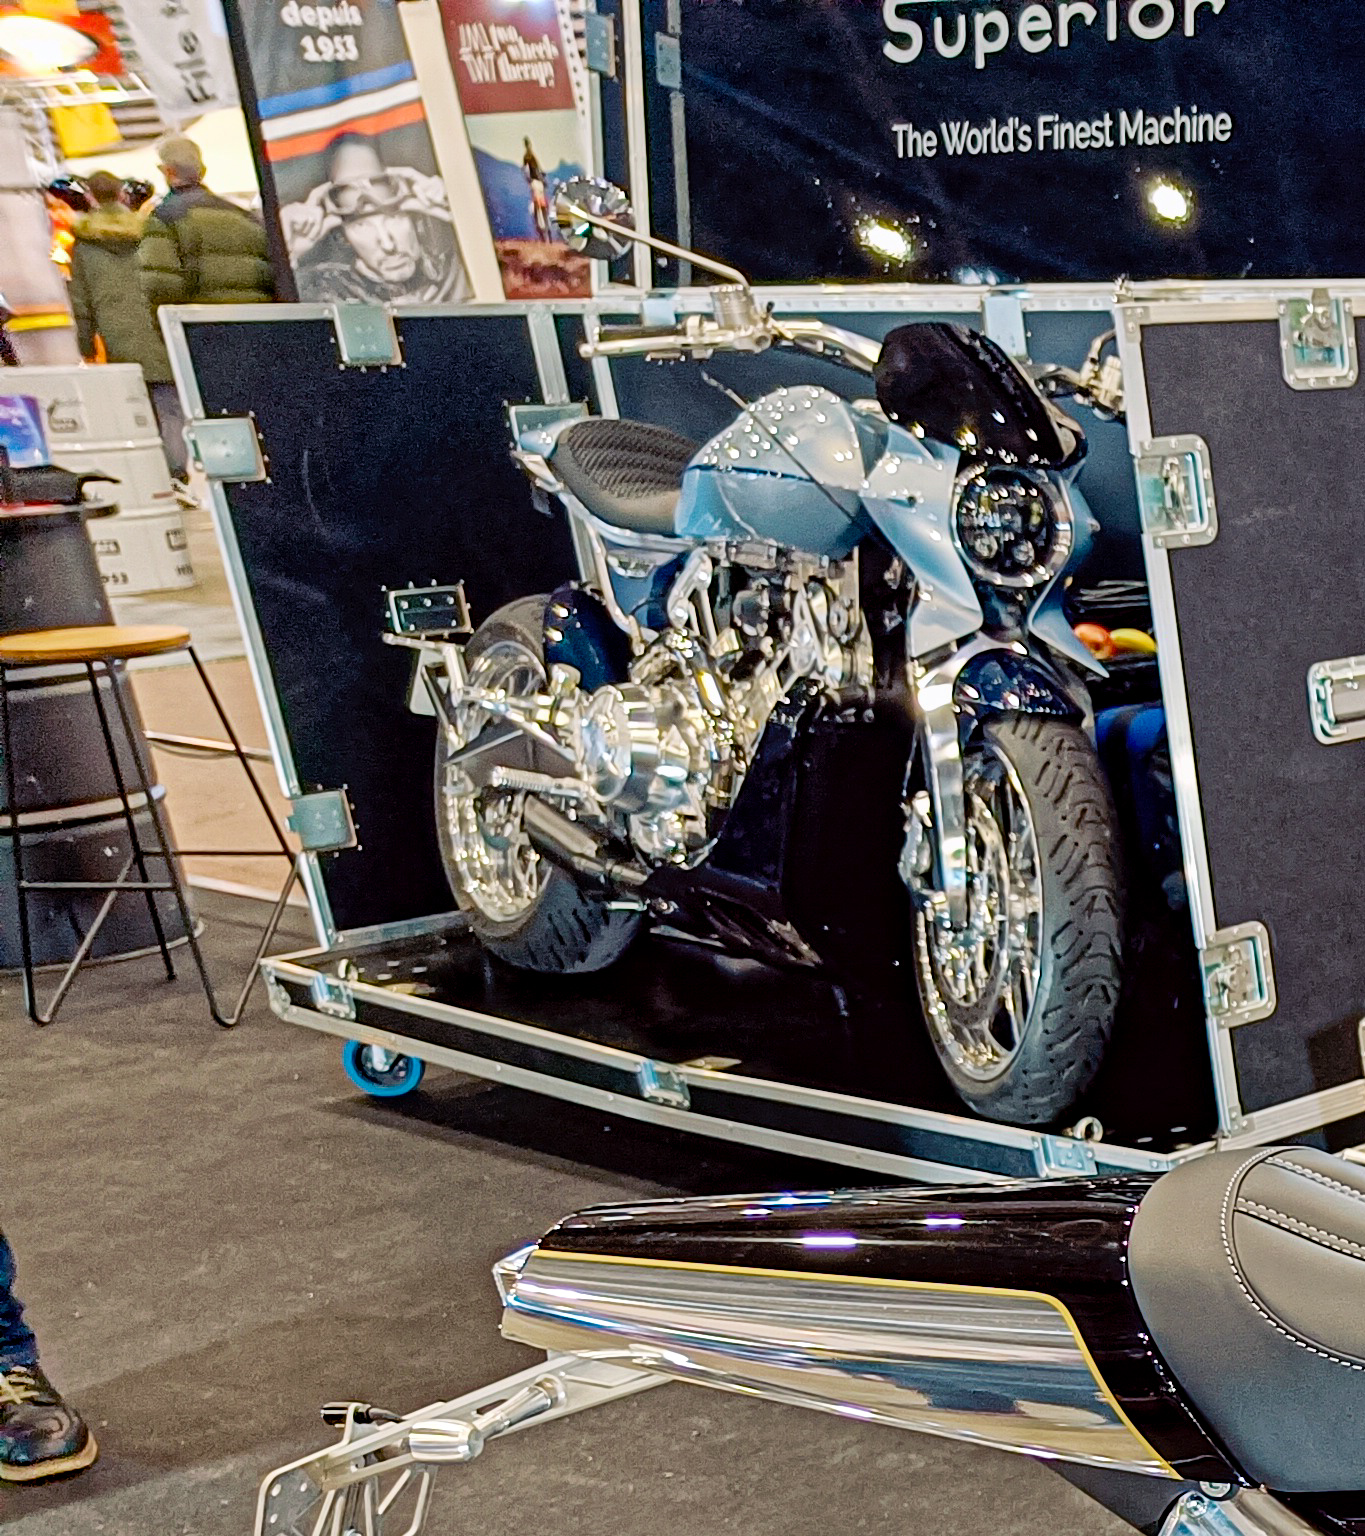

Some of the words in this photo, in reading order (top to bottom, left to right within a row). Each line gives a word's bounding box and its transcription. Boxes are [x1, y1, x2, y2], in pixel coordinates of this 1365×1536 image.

[882, 0, 1227, 69] Superior
[892, 123, 937, 158] The
[942, 115, 1032, 156] World's
[1038, 112, 1113, 151] Finest
[1119, 105, 1232, 147] Machine
